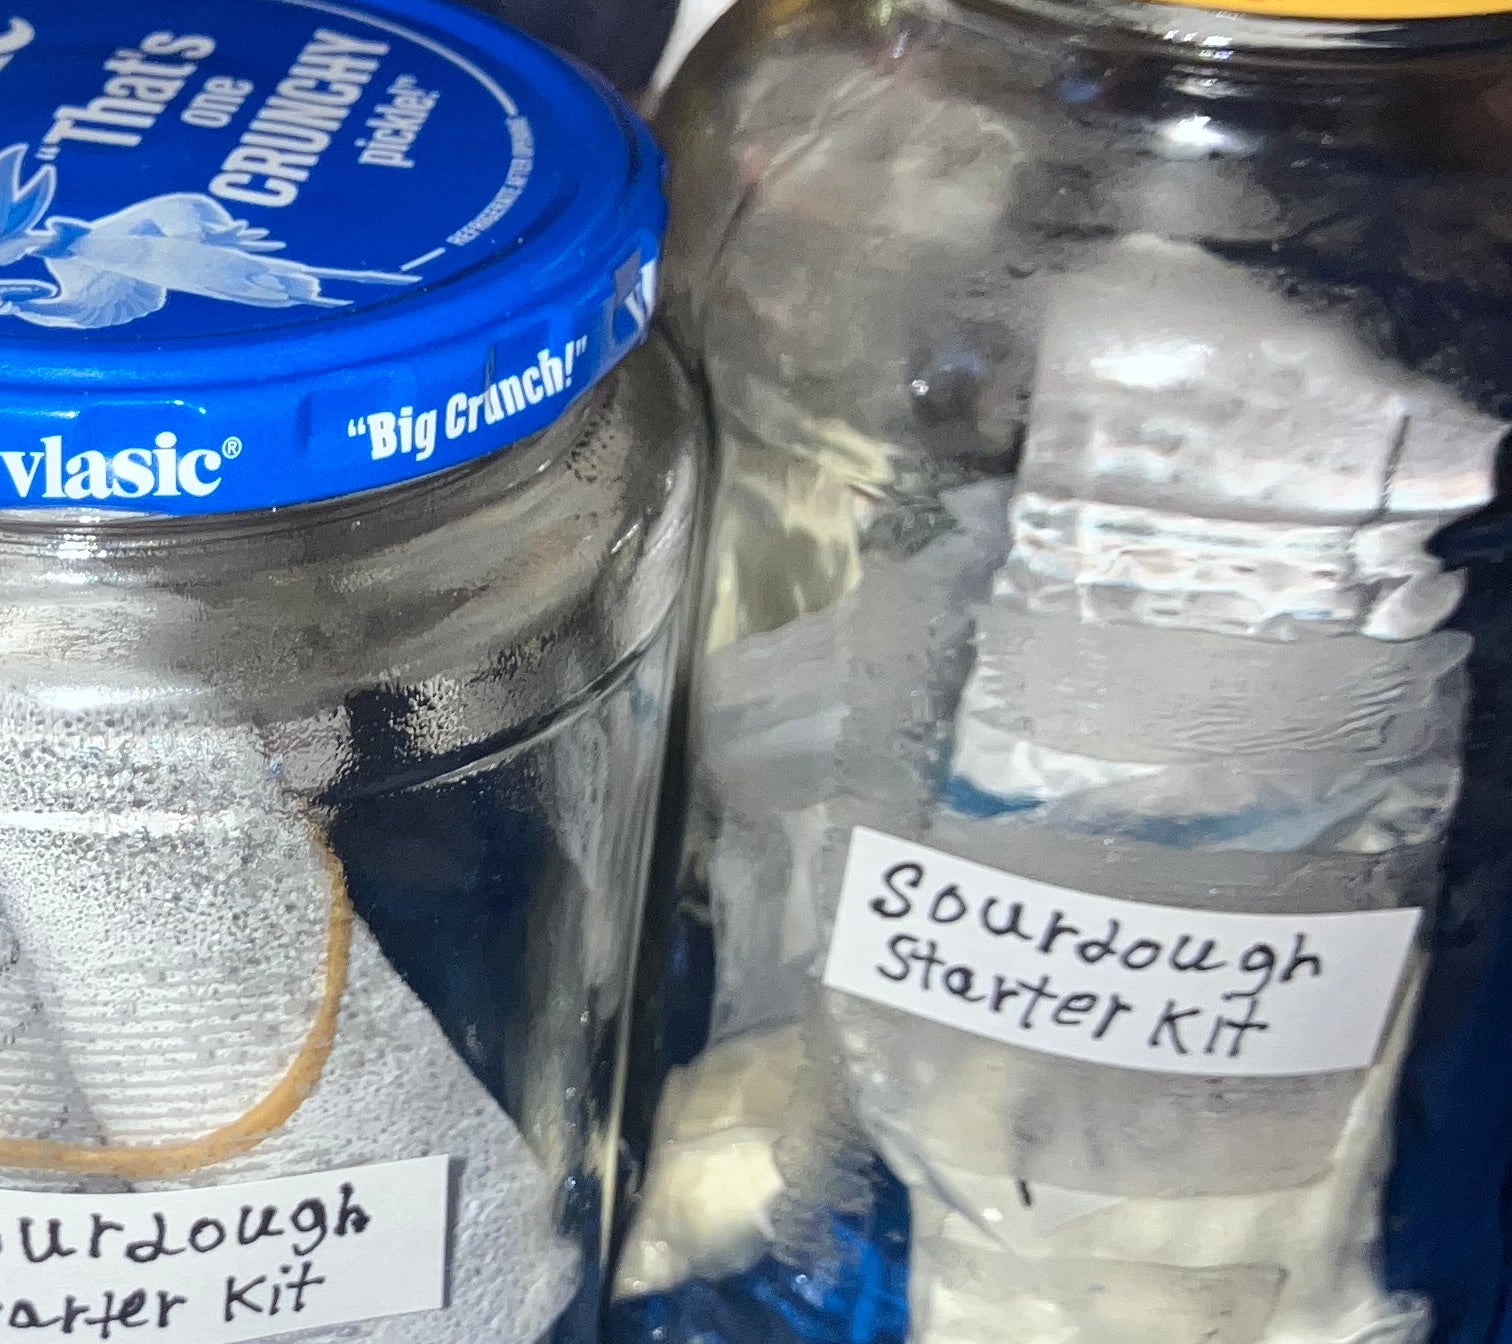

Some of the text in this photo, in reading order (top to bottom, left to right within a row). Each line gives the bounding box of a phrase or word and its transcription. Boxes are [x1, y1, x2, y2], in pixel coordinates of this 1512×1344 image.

[181, 75, 254, 129] one
[208, 28, 391, 208] CRUNCHY
[346, 334, 588, 462] “Big Crunch!”
[869, 861, 1322, 1001] Sourdough
[876, 932, 1270, 1057] Starter Kit
[224, 1261, 326, 1324] Kit
